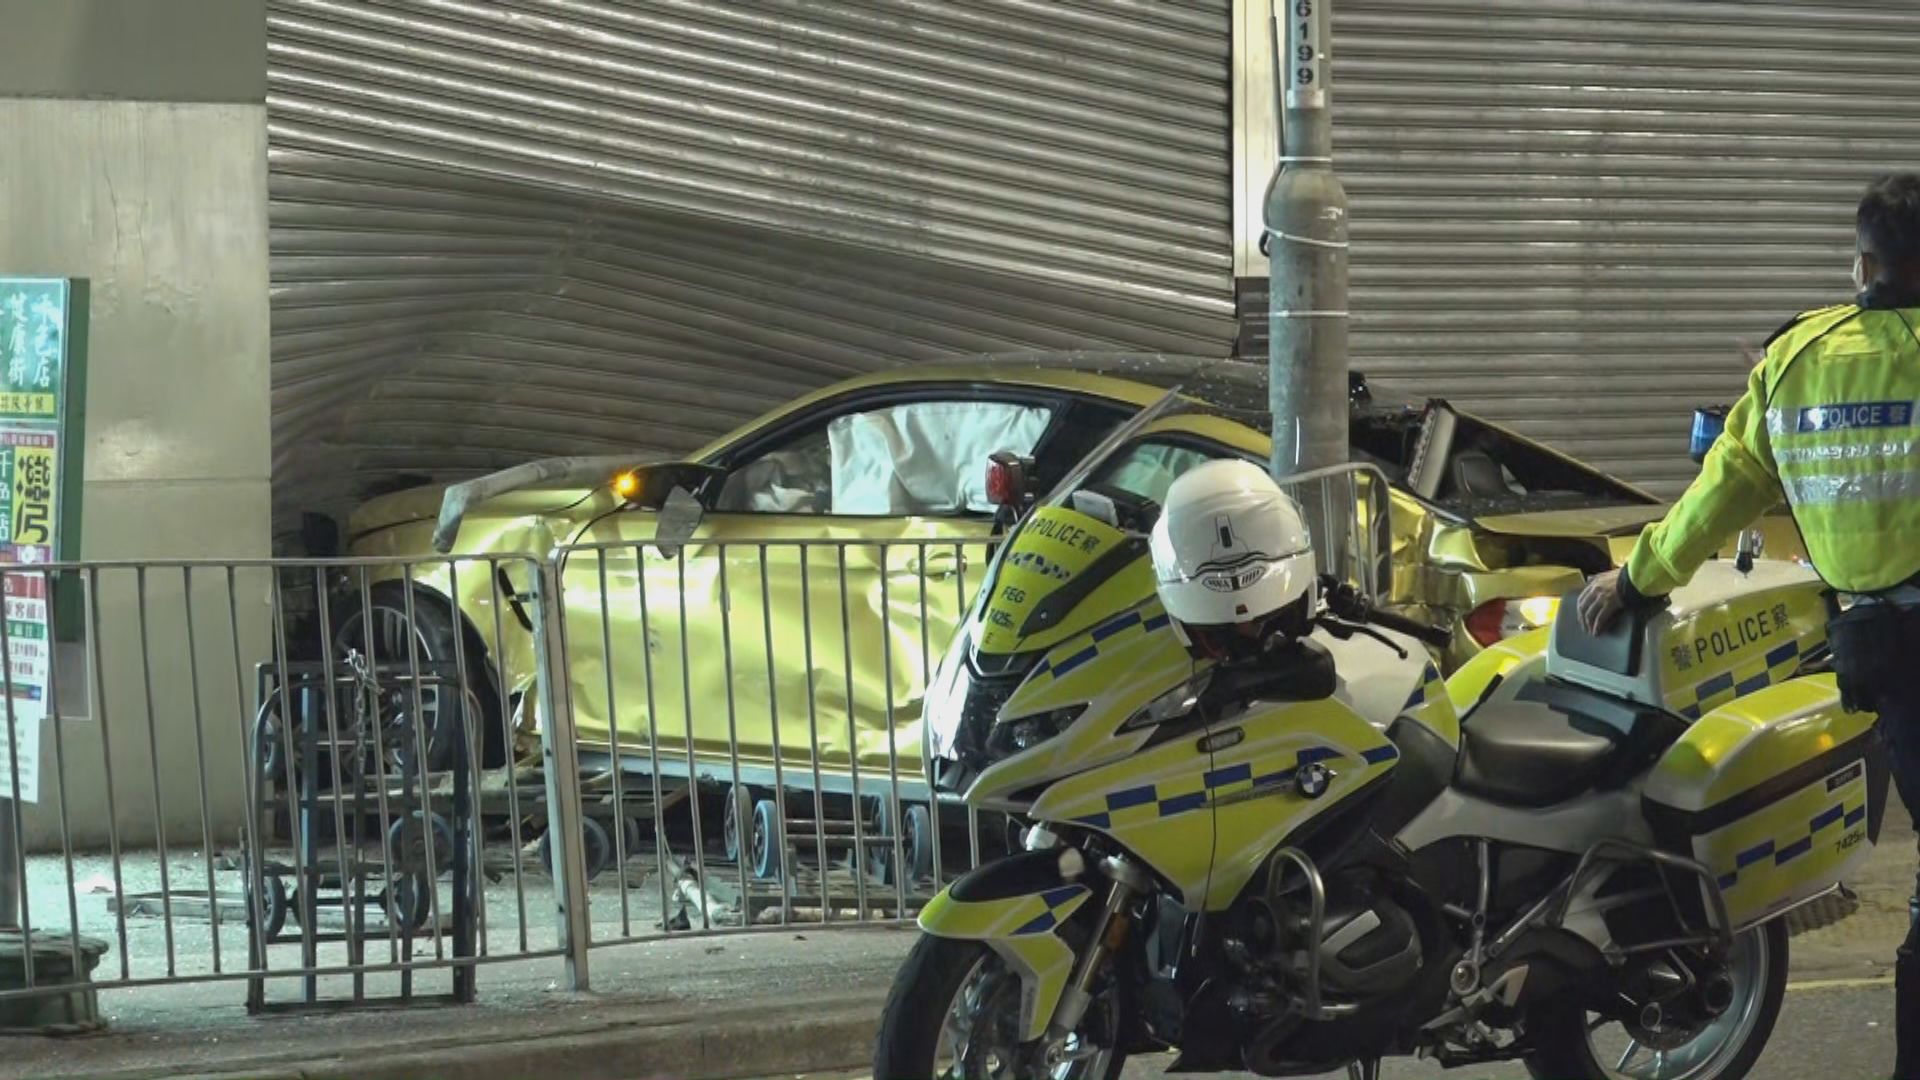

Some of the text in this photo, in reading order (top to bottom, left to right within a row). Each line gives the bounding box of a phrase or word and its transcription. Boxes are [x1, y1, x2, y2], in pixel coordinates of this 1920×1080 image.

[1296, 0, 1313, 85] 6199
[1820, 406, 1880, 427] POLICE
[1033, 517, 1085, 547] POLICE
[1695, 610, 1772, 663] POLICE
